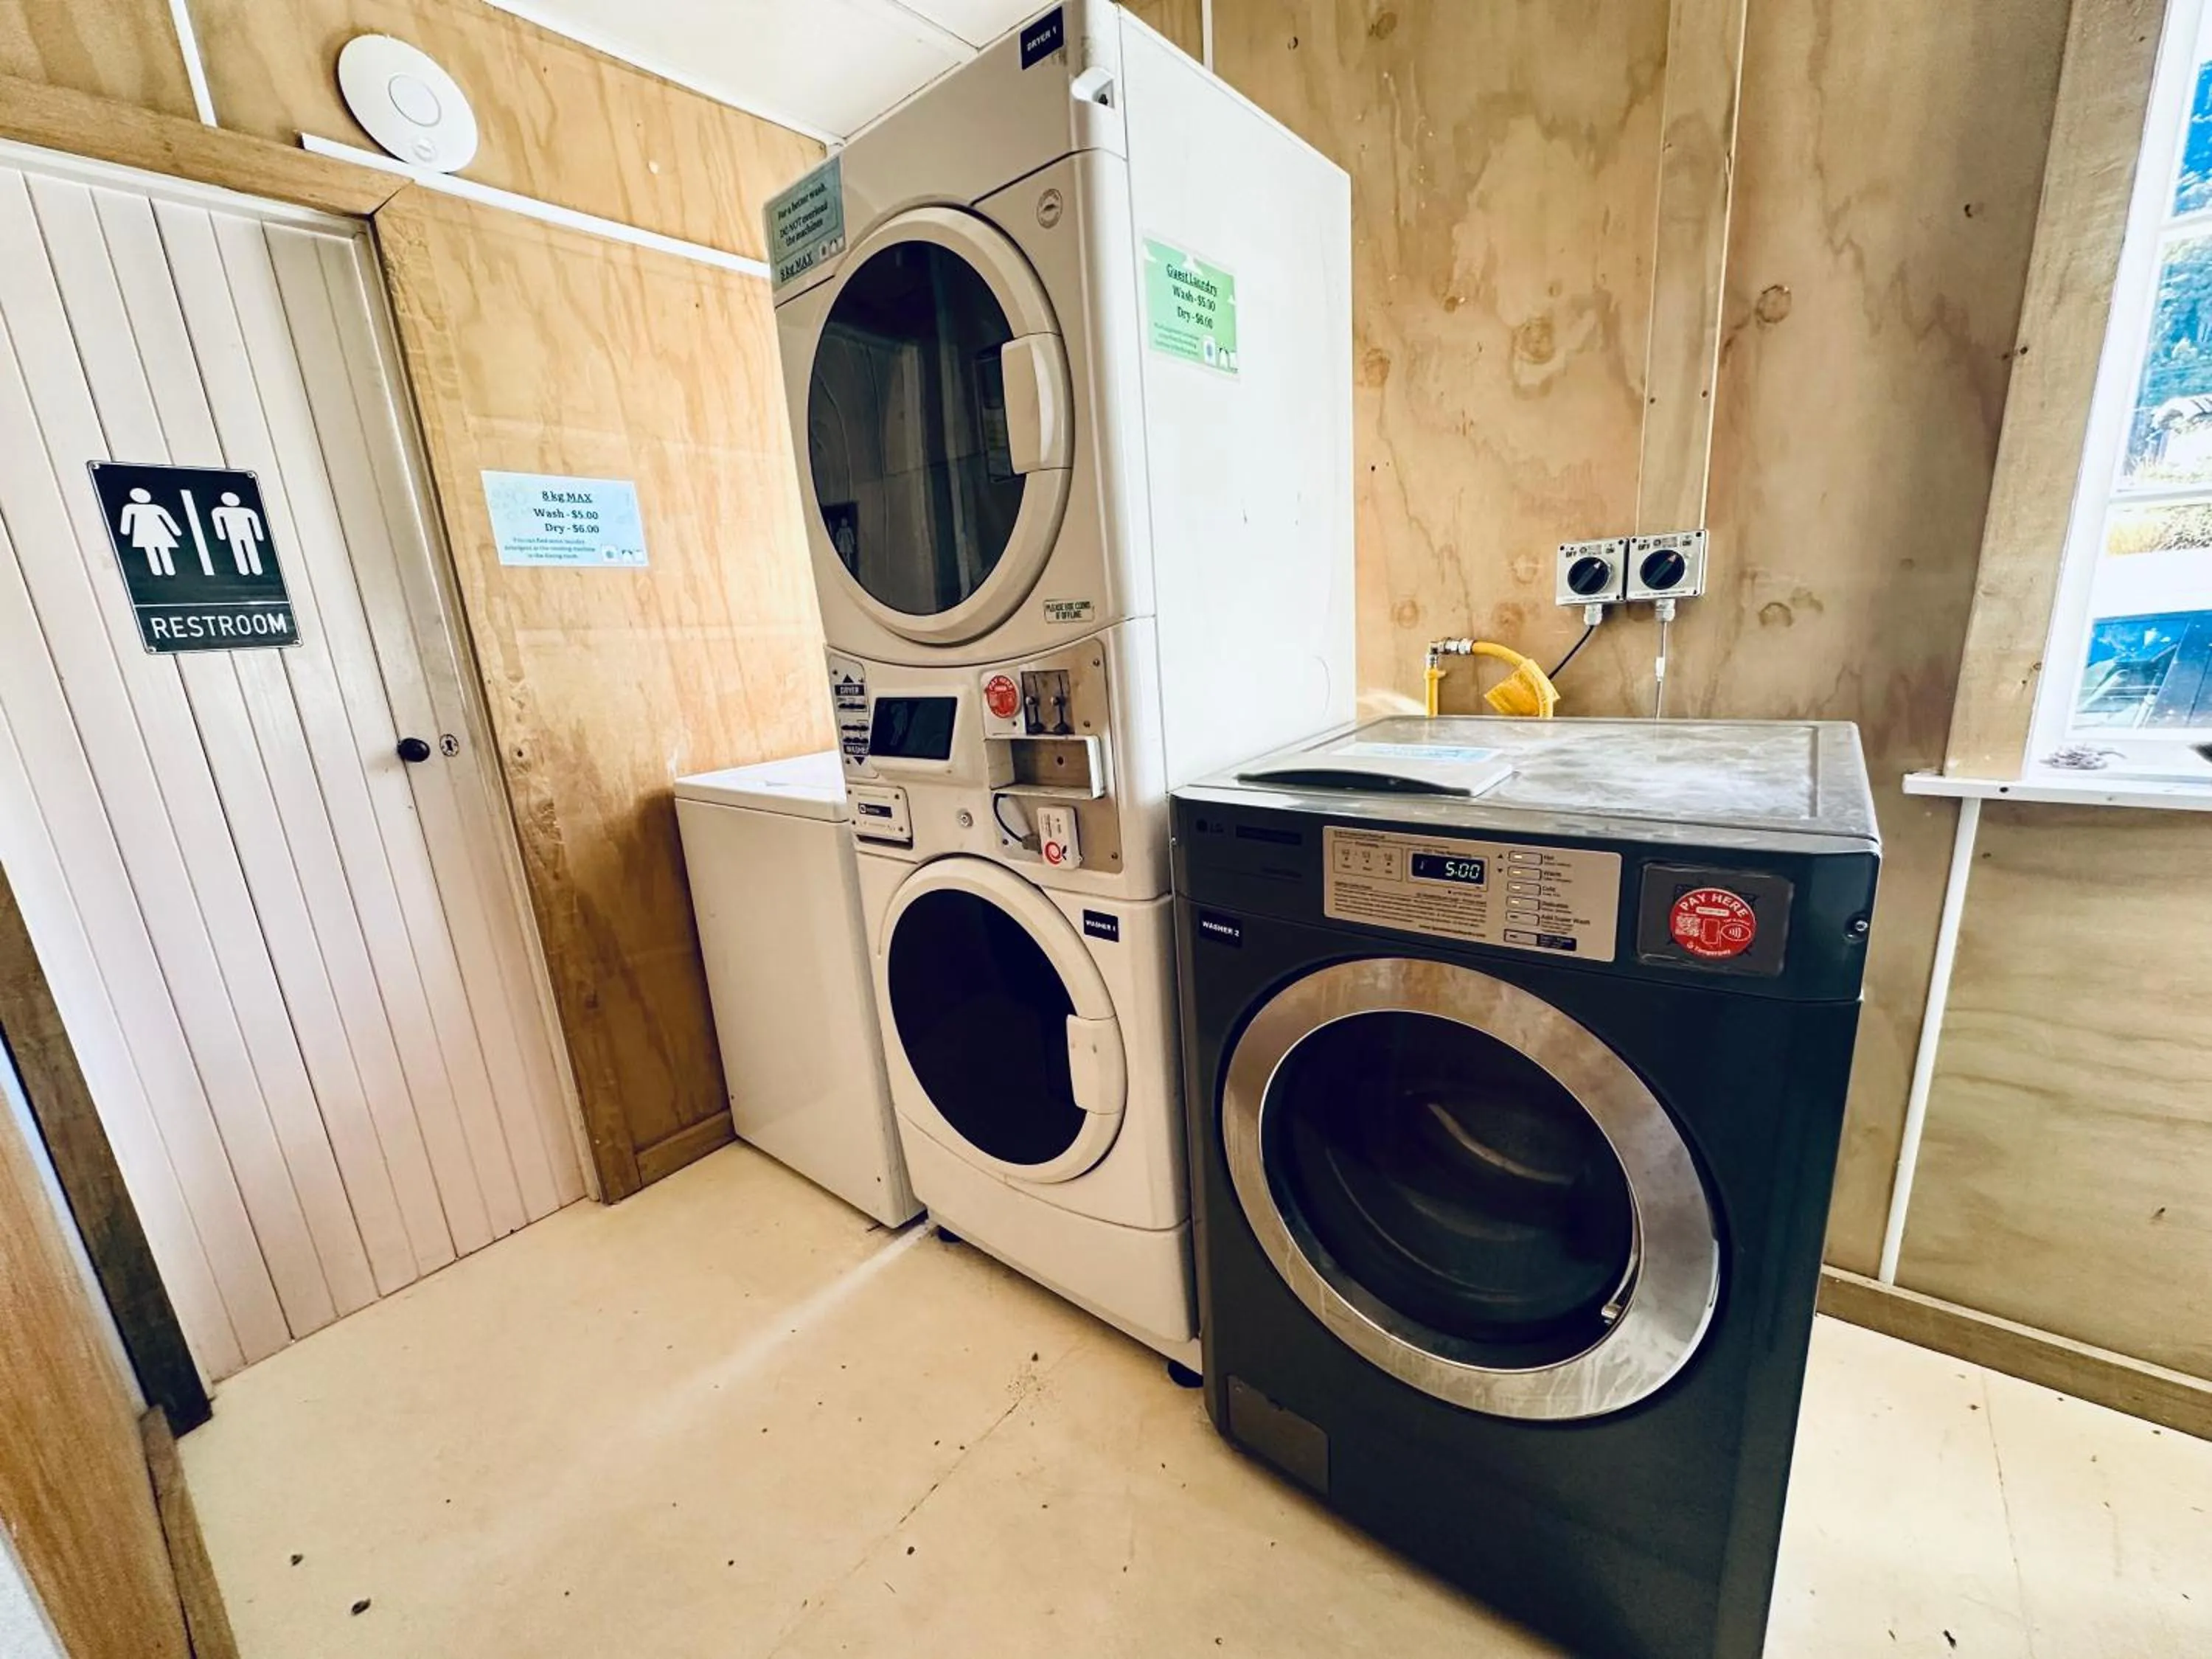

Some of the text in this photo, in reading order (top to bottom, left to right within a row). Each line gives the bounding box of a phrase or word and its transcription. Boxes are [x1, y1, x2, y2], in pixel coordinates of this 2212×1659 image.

[1027, 25, 1057, 52] DRYER 1
[795, 251, 813, 273] MAX
[1166, 263, 1189, 285] Guest
[1172, 285, 1194, 302] Wash
[1177, 306, 1191, 323] Dry
[542, 490, 593, 504] 8 kg MAX
[533, 507, 565, 518] Wash
[571, 510, 599, 520] $5.00
[545, 523, 565, 535] Dry
[572, 524, 600, 534] $6.00
[150, 613, 288, 639] RESTROOM
[1679, 892, 1749, 918] PAY HERE
[1085, 919, 1111, 932] WASHER
[1201, 919, 1240, 937] WASHER 2
